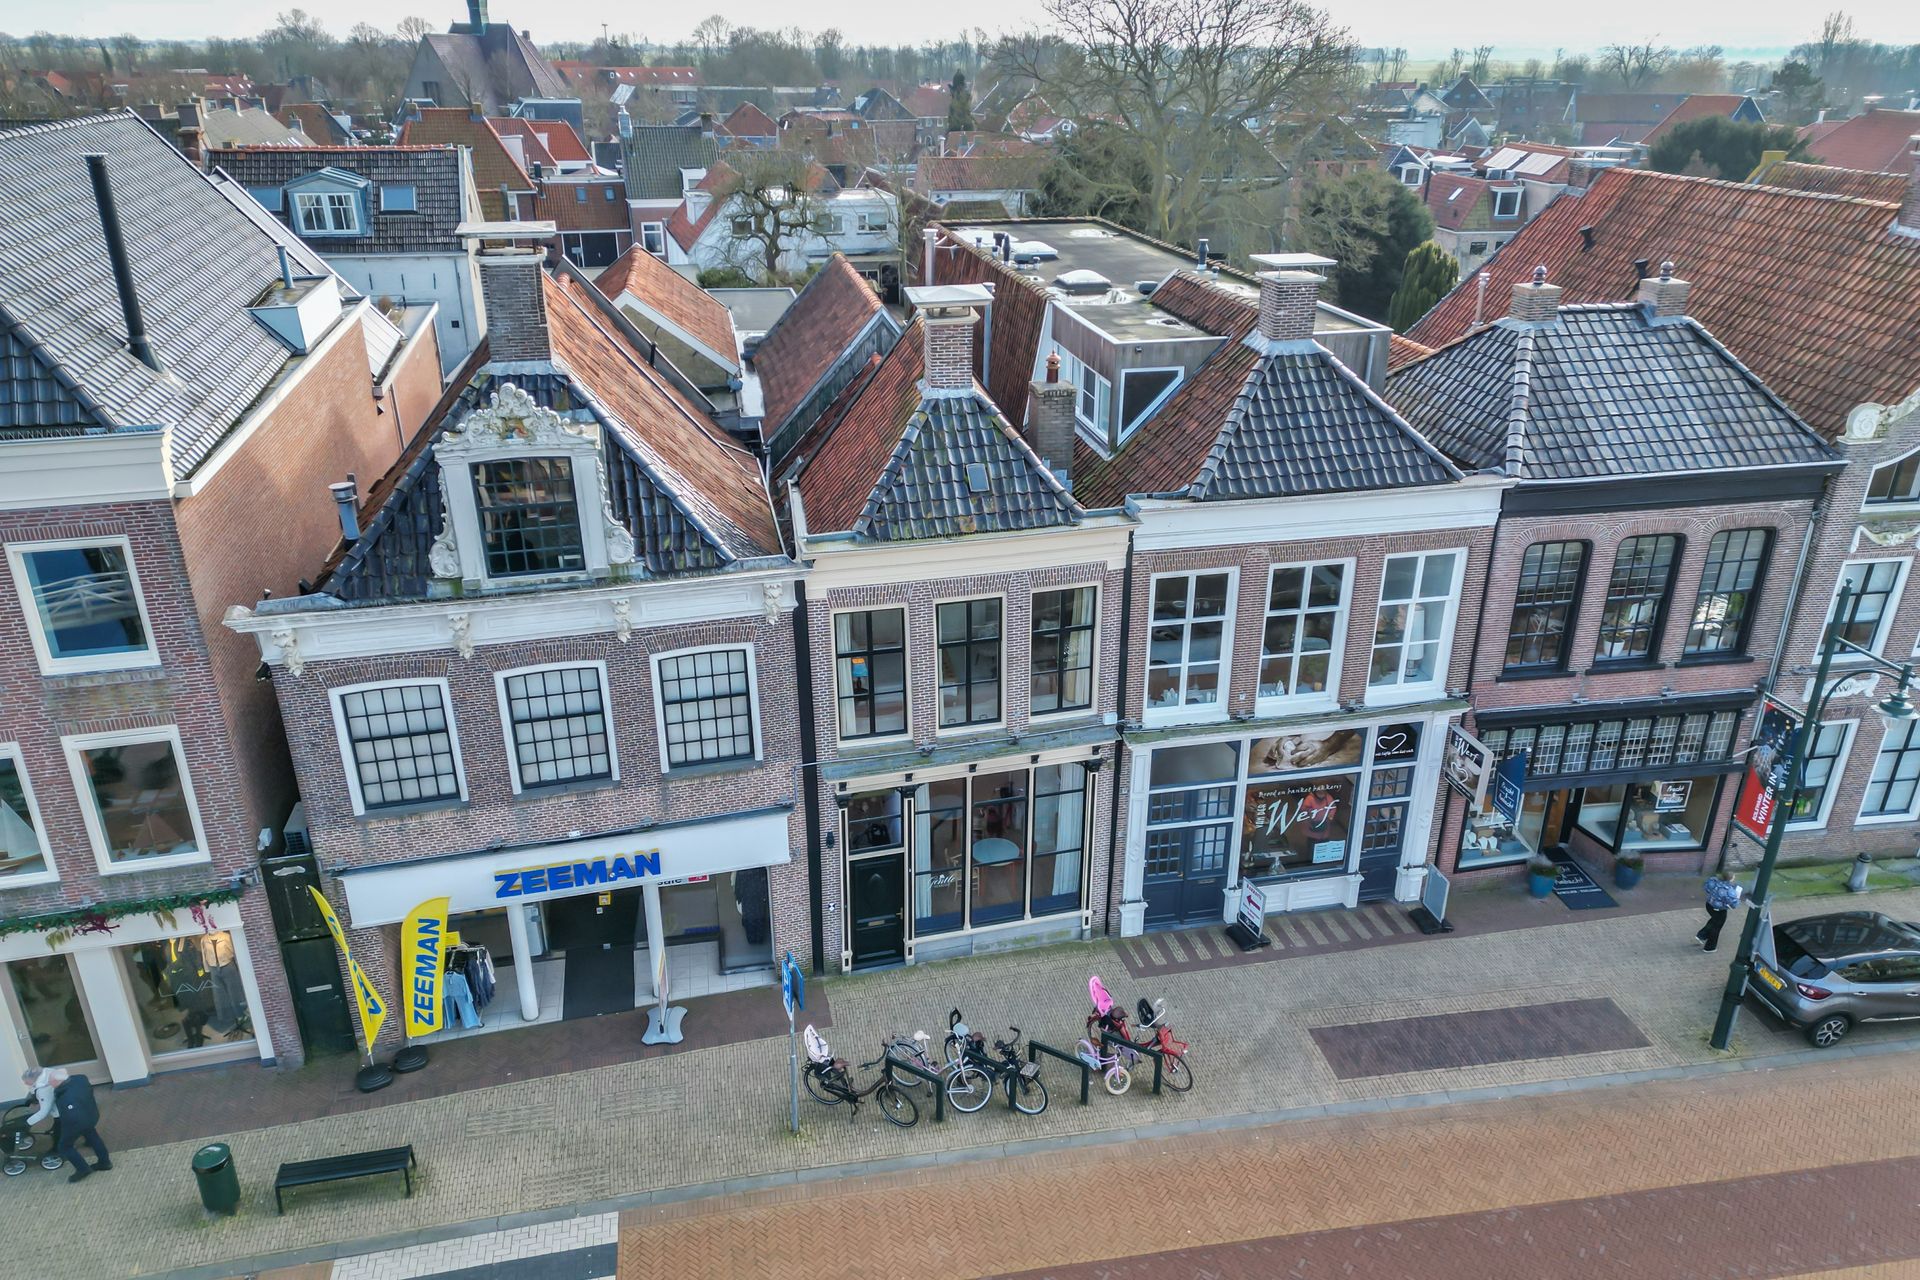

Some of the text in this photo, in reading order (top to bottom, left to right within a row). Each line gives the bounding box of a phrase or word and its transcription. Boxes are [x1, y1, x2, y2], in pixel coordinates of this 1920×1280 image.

[1265, 798, 1340, 836] Werf
[1757, 772, 1778, 824] WINTER IN
[494, 849, 662, 899] ZEEMAN
[414, 918, 441, 1026] ZEEMAN
